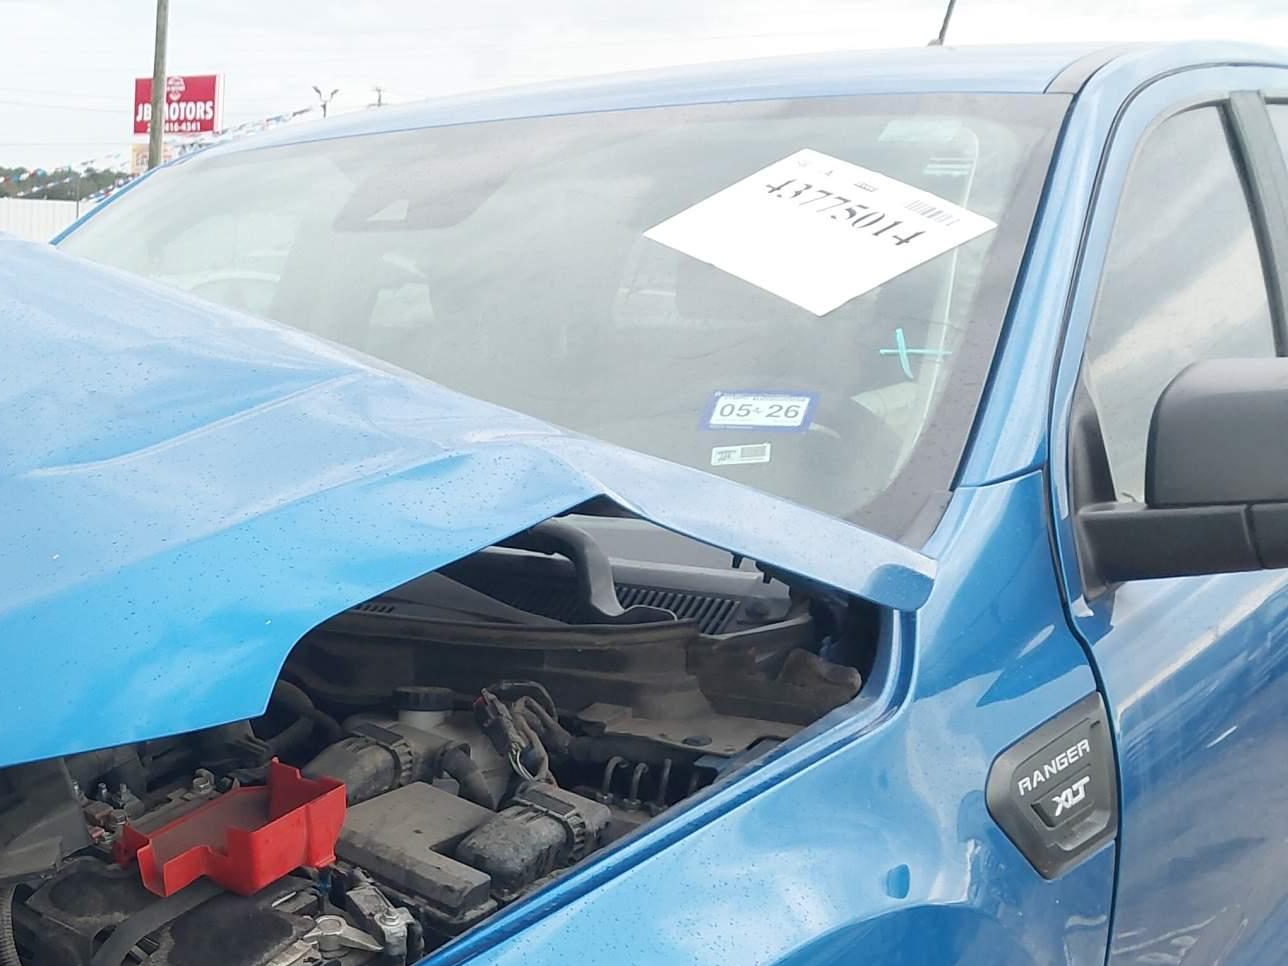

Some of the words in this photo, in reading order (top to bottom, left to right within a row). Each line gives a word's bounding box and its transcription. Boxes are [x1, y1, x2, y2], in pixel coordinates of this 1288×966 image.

[765, 178, 926, 246] 43775014
[719, 403, 753, 418] 05
[765, 404, 801, 419] 26
[1017, 738, 1091, 796] RANGER
[1051, 776, 1091, 817] XLT
